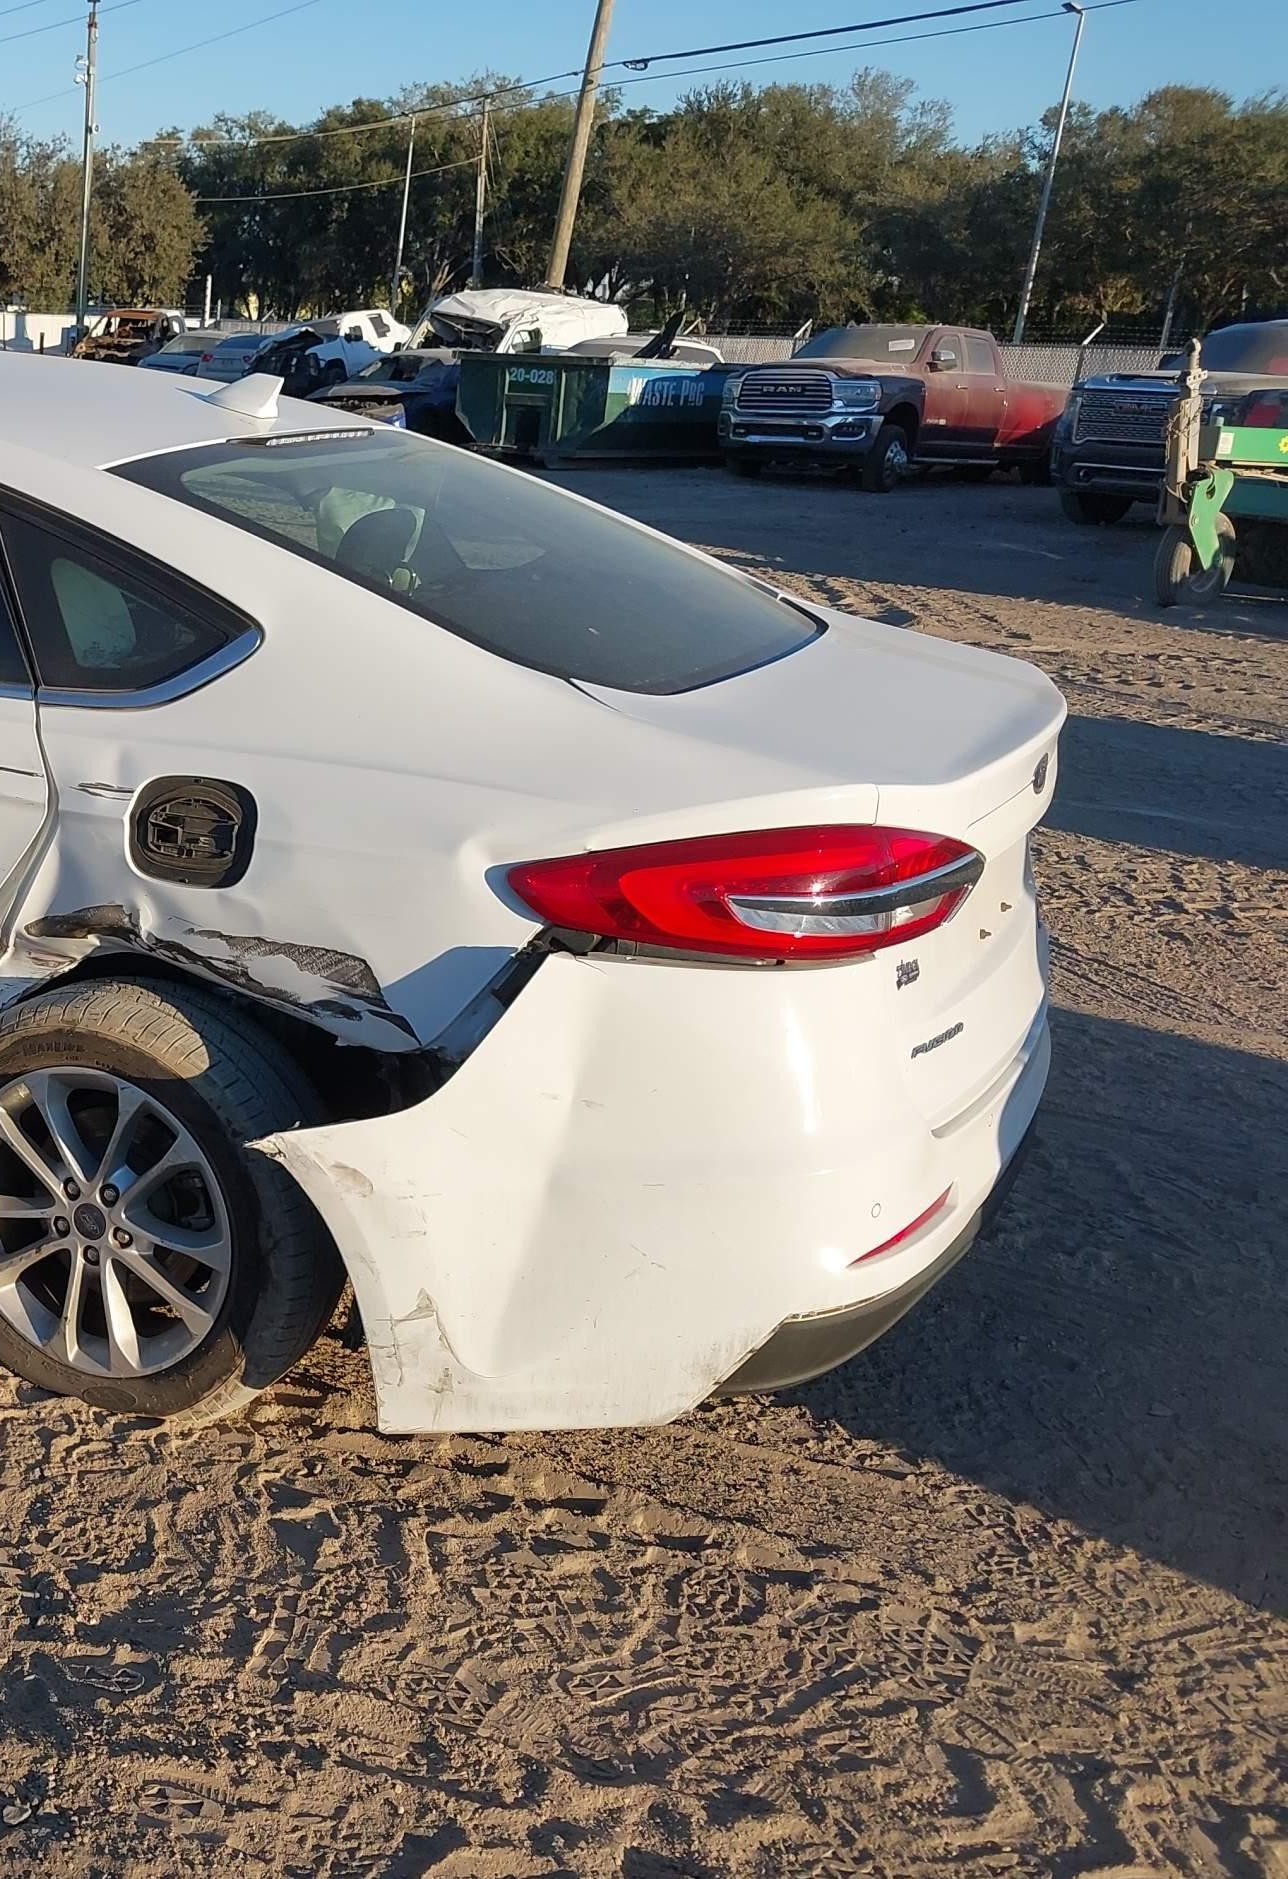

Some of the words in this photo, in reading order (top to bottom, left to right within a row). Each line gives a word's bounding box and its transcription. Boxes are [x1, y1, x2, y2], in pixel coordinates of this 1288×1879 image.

[509, 367, 554, 385] 20-028
[626, 376, 677, 406] WASTE
[762, 385, 802, 393] RAM
[910, 1021, 964, 1059] FUSION
